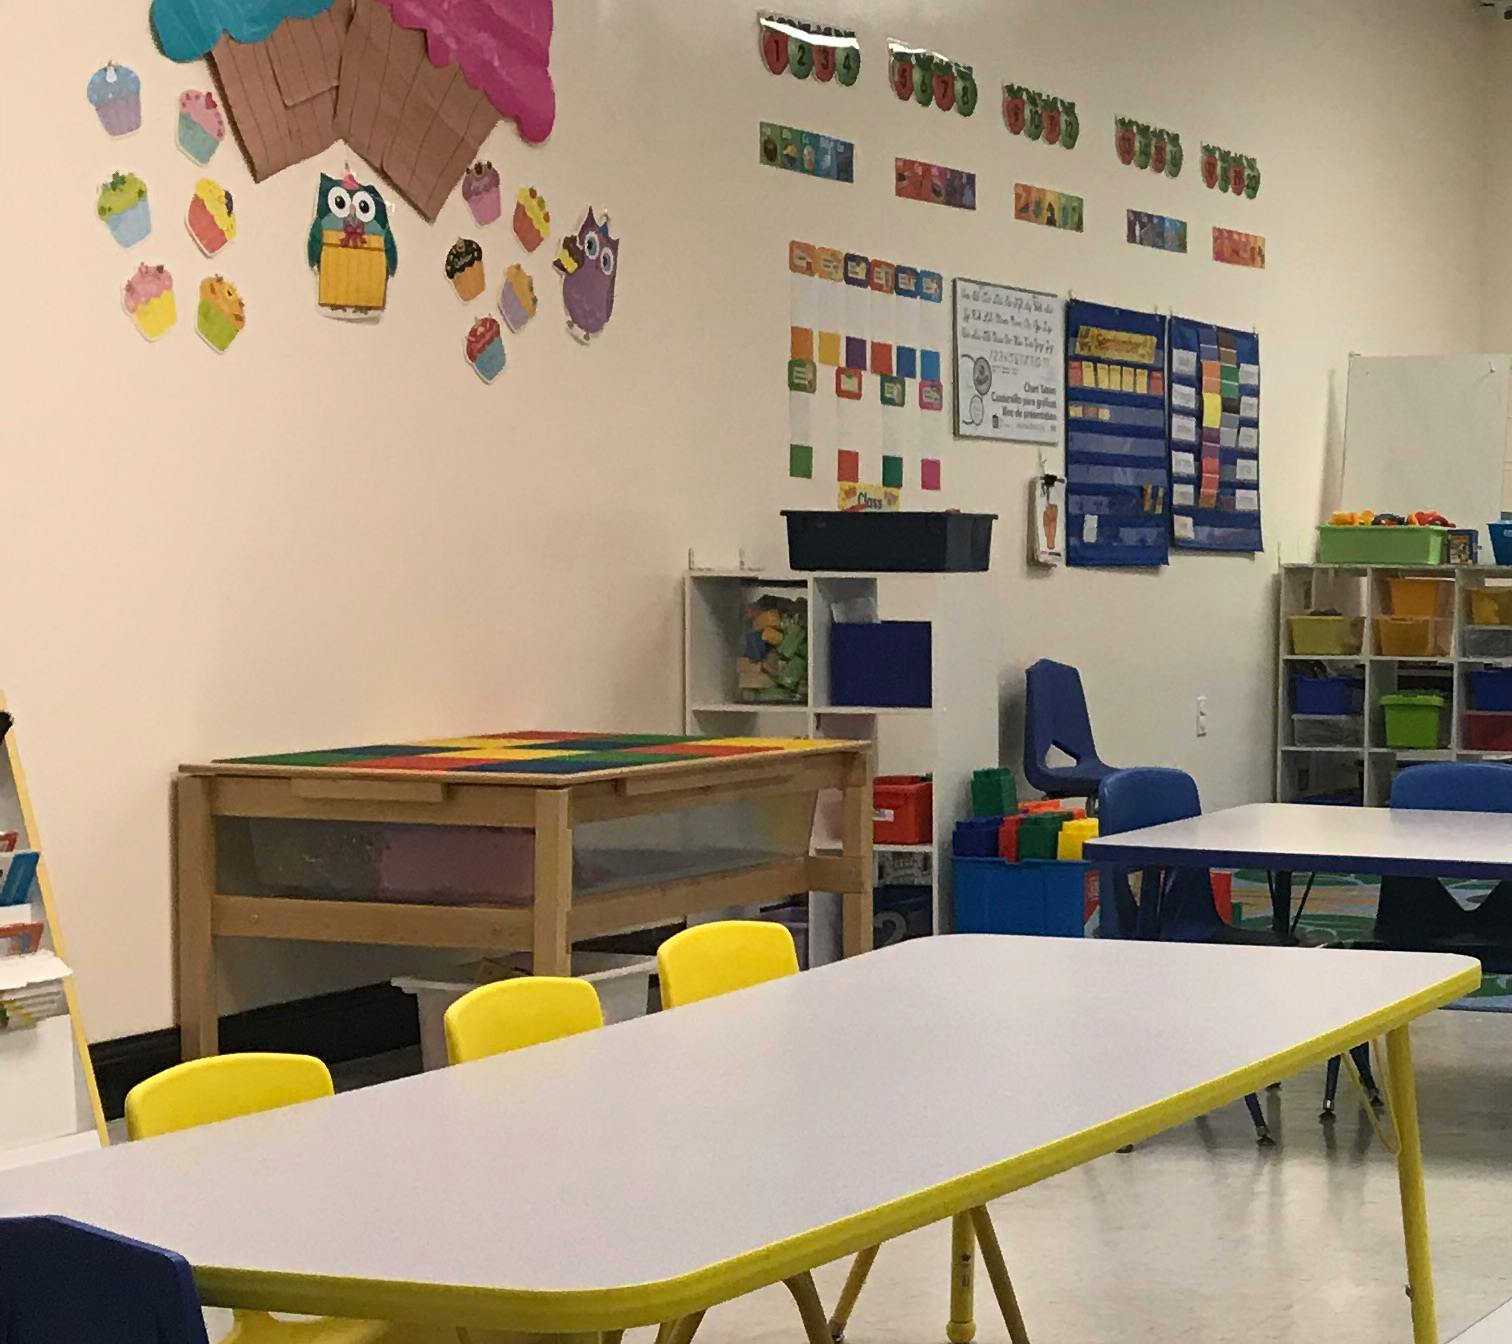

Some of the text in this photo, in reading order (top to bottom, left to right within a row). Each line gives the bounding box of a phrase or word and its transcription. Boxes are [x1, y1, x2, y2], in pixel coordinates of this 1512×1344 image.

[774, 39, 852, 71] 1 2 3 4
[900, 67, 969, 105] 5 6 7 8
[857, 492, 883, 510] Class
